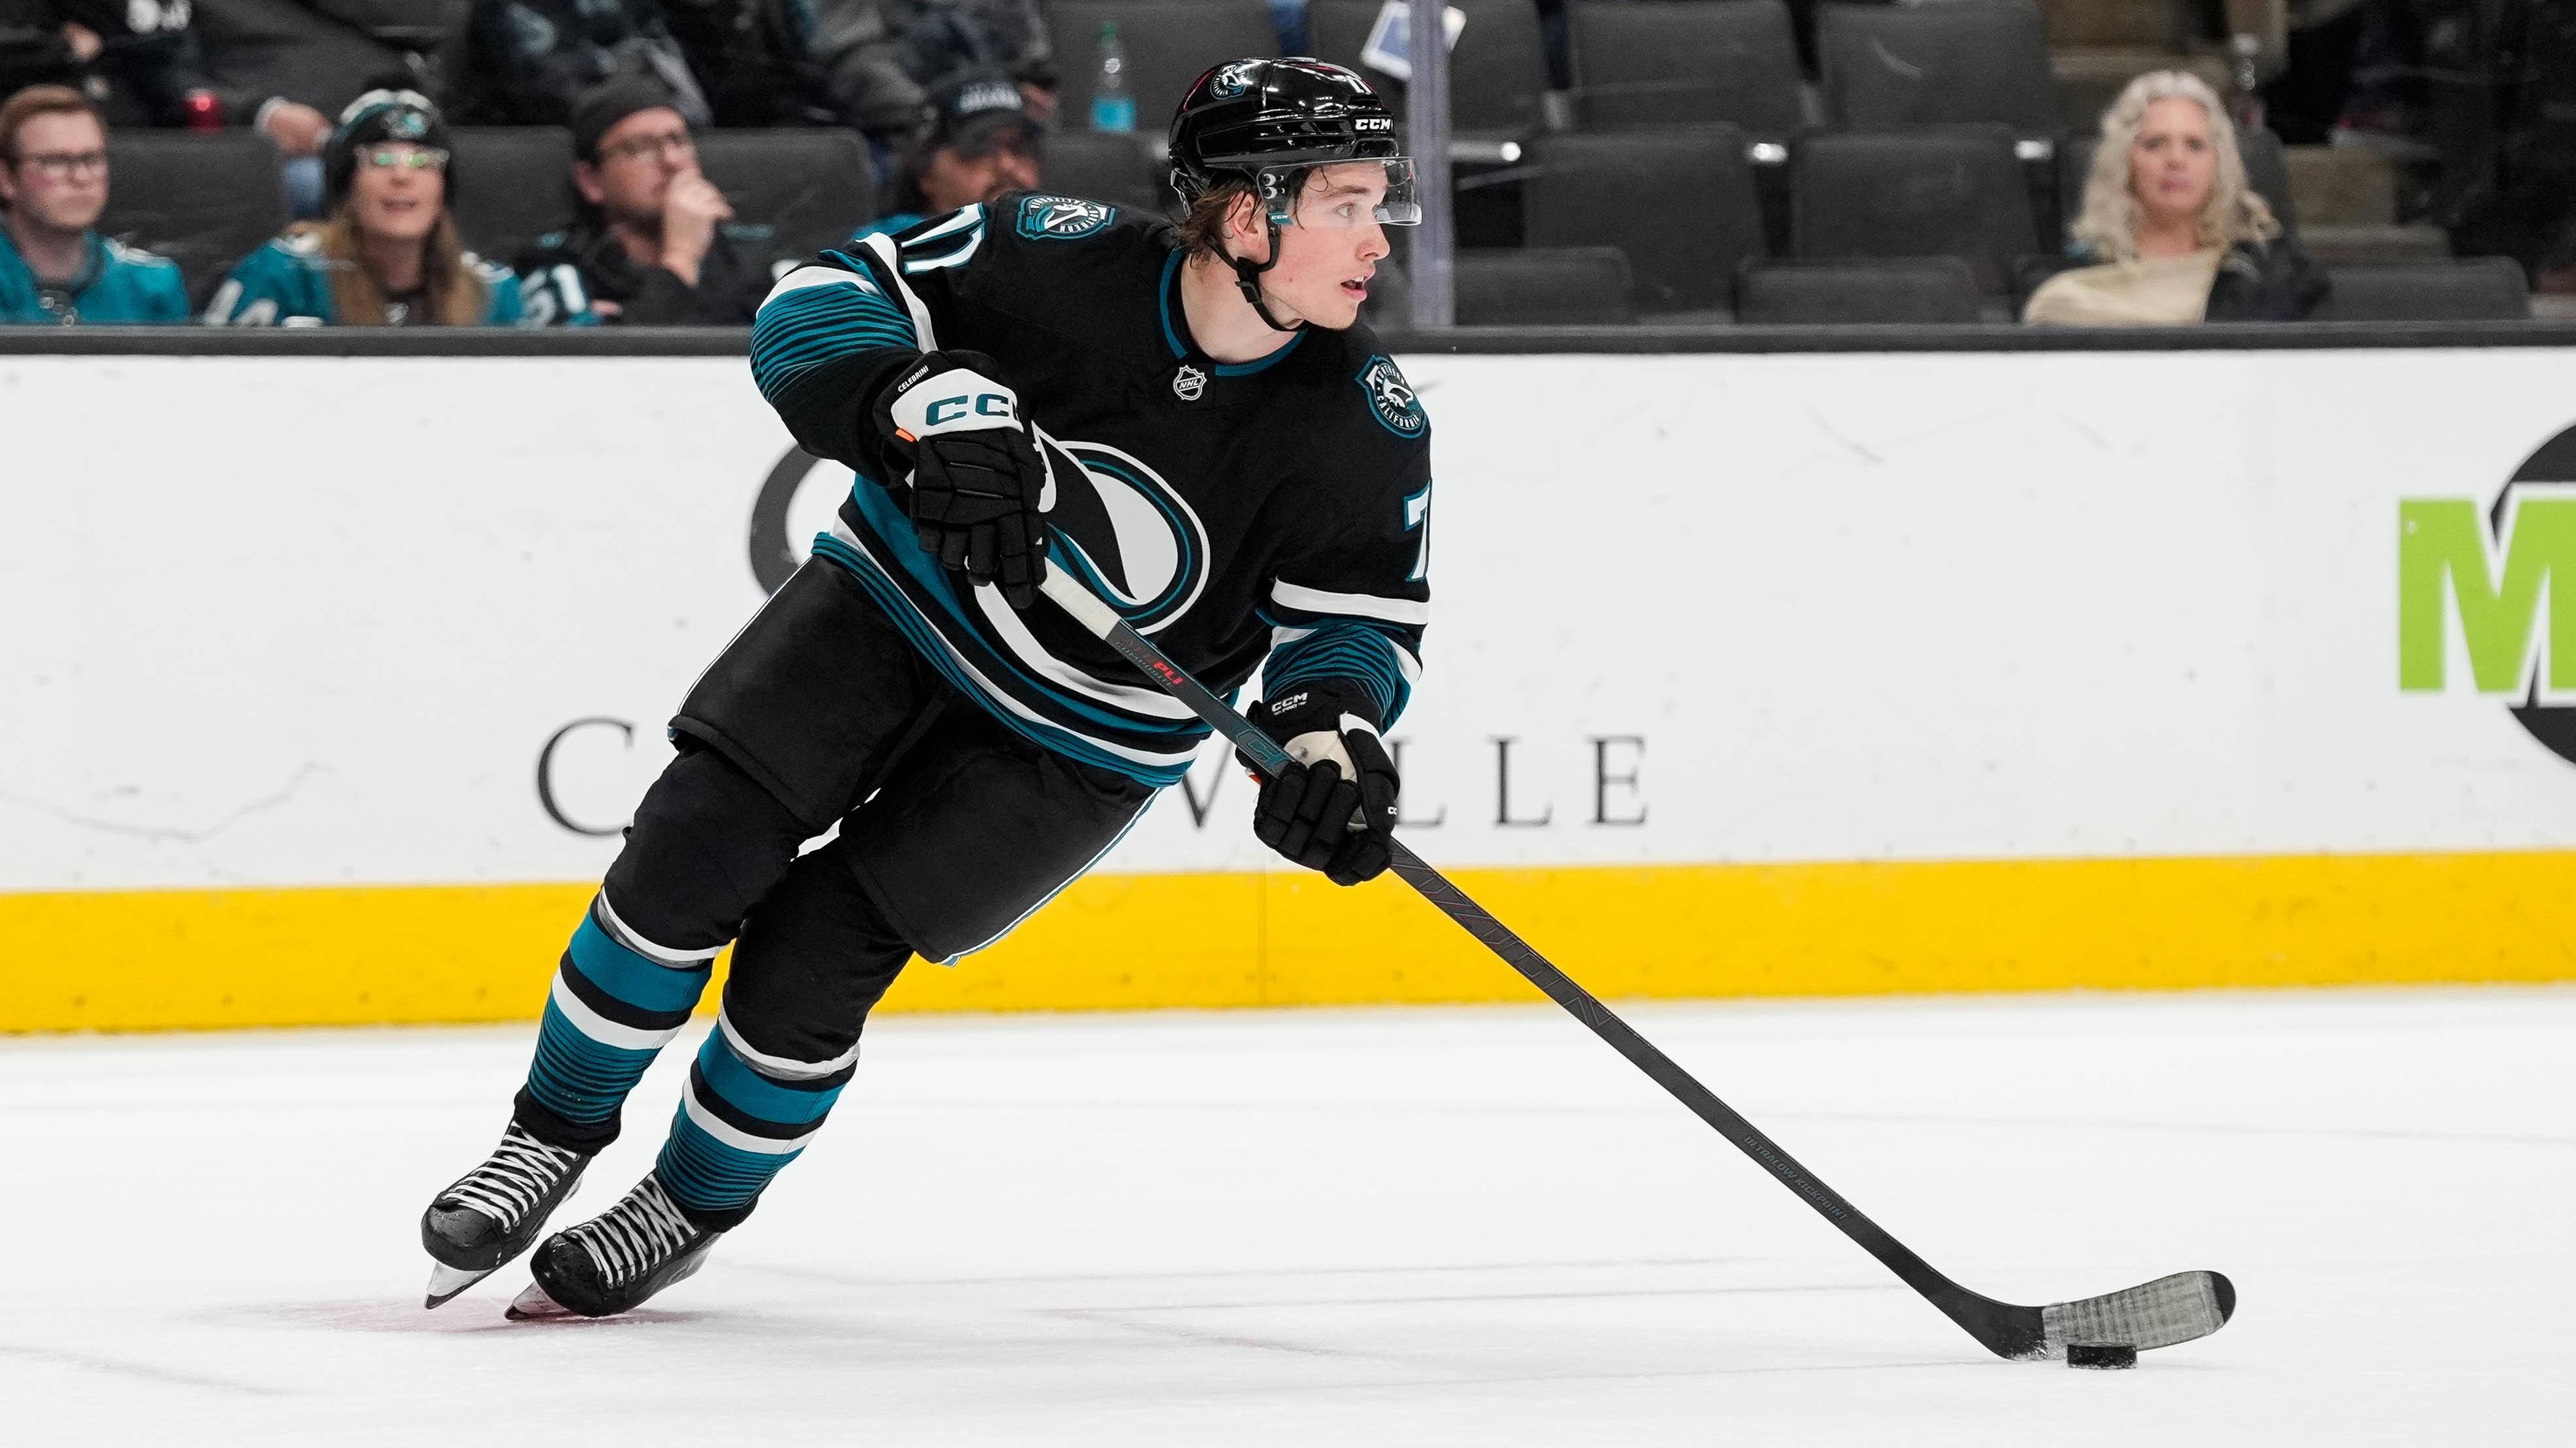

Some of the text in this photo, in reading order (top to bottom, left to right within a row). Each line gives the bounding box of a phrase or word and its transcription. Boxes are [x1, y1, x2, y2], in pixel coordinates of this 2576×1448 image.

[1355, 118, 1391, 130] CCM
[898, 365, 929, 393] CELEBRINI
[1179, 379, 1199, 389] NHL
[925, 393, 1020, 426] CC
[1272, 693, 1308, 712] CCM
[1744, 1136, 1848, 1221] ULTRALOW KICKPOINT
